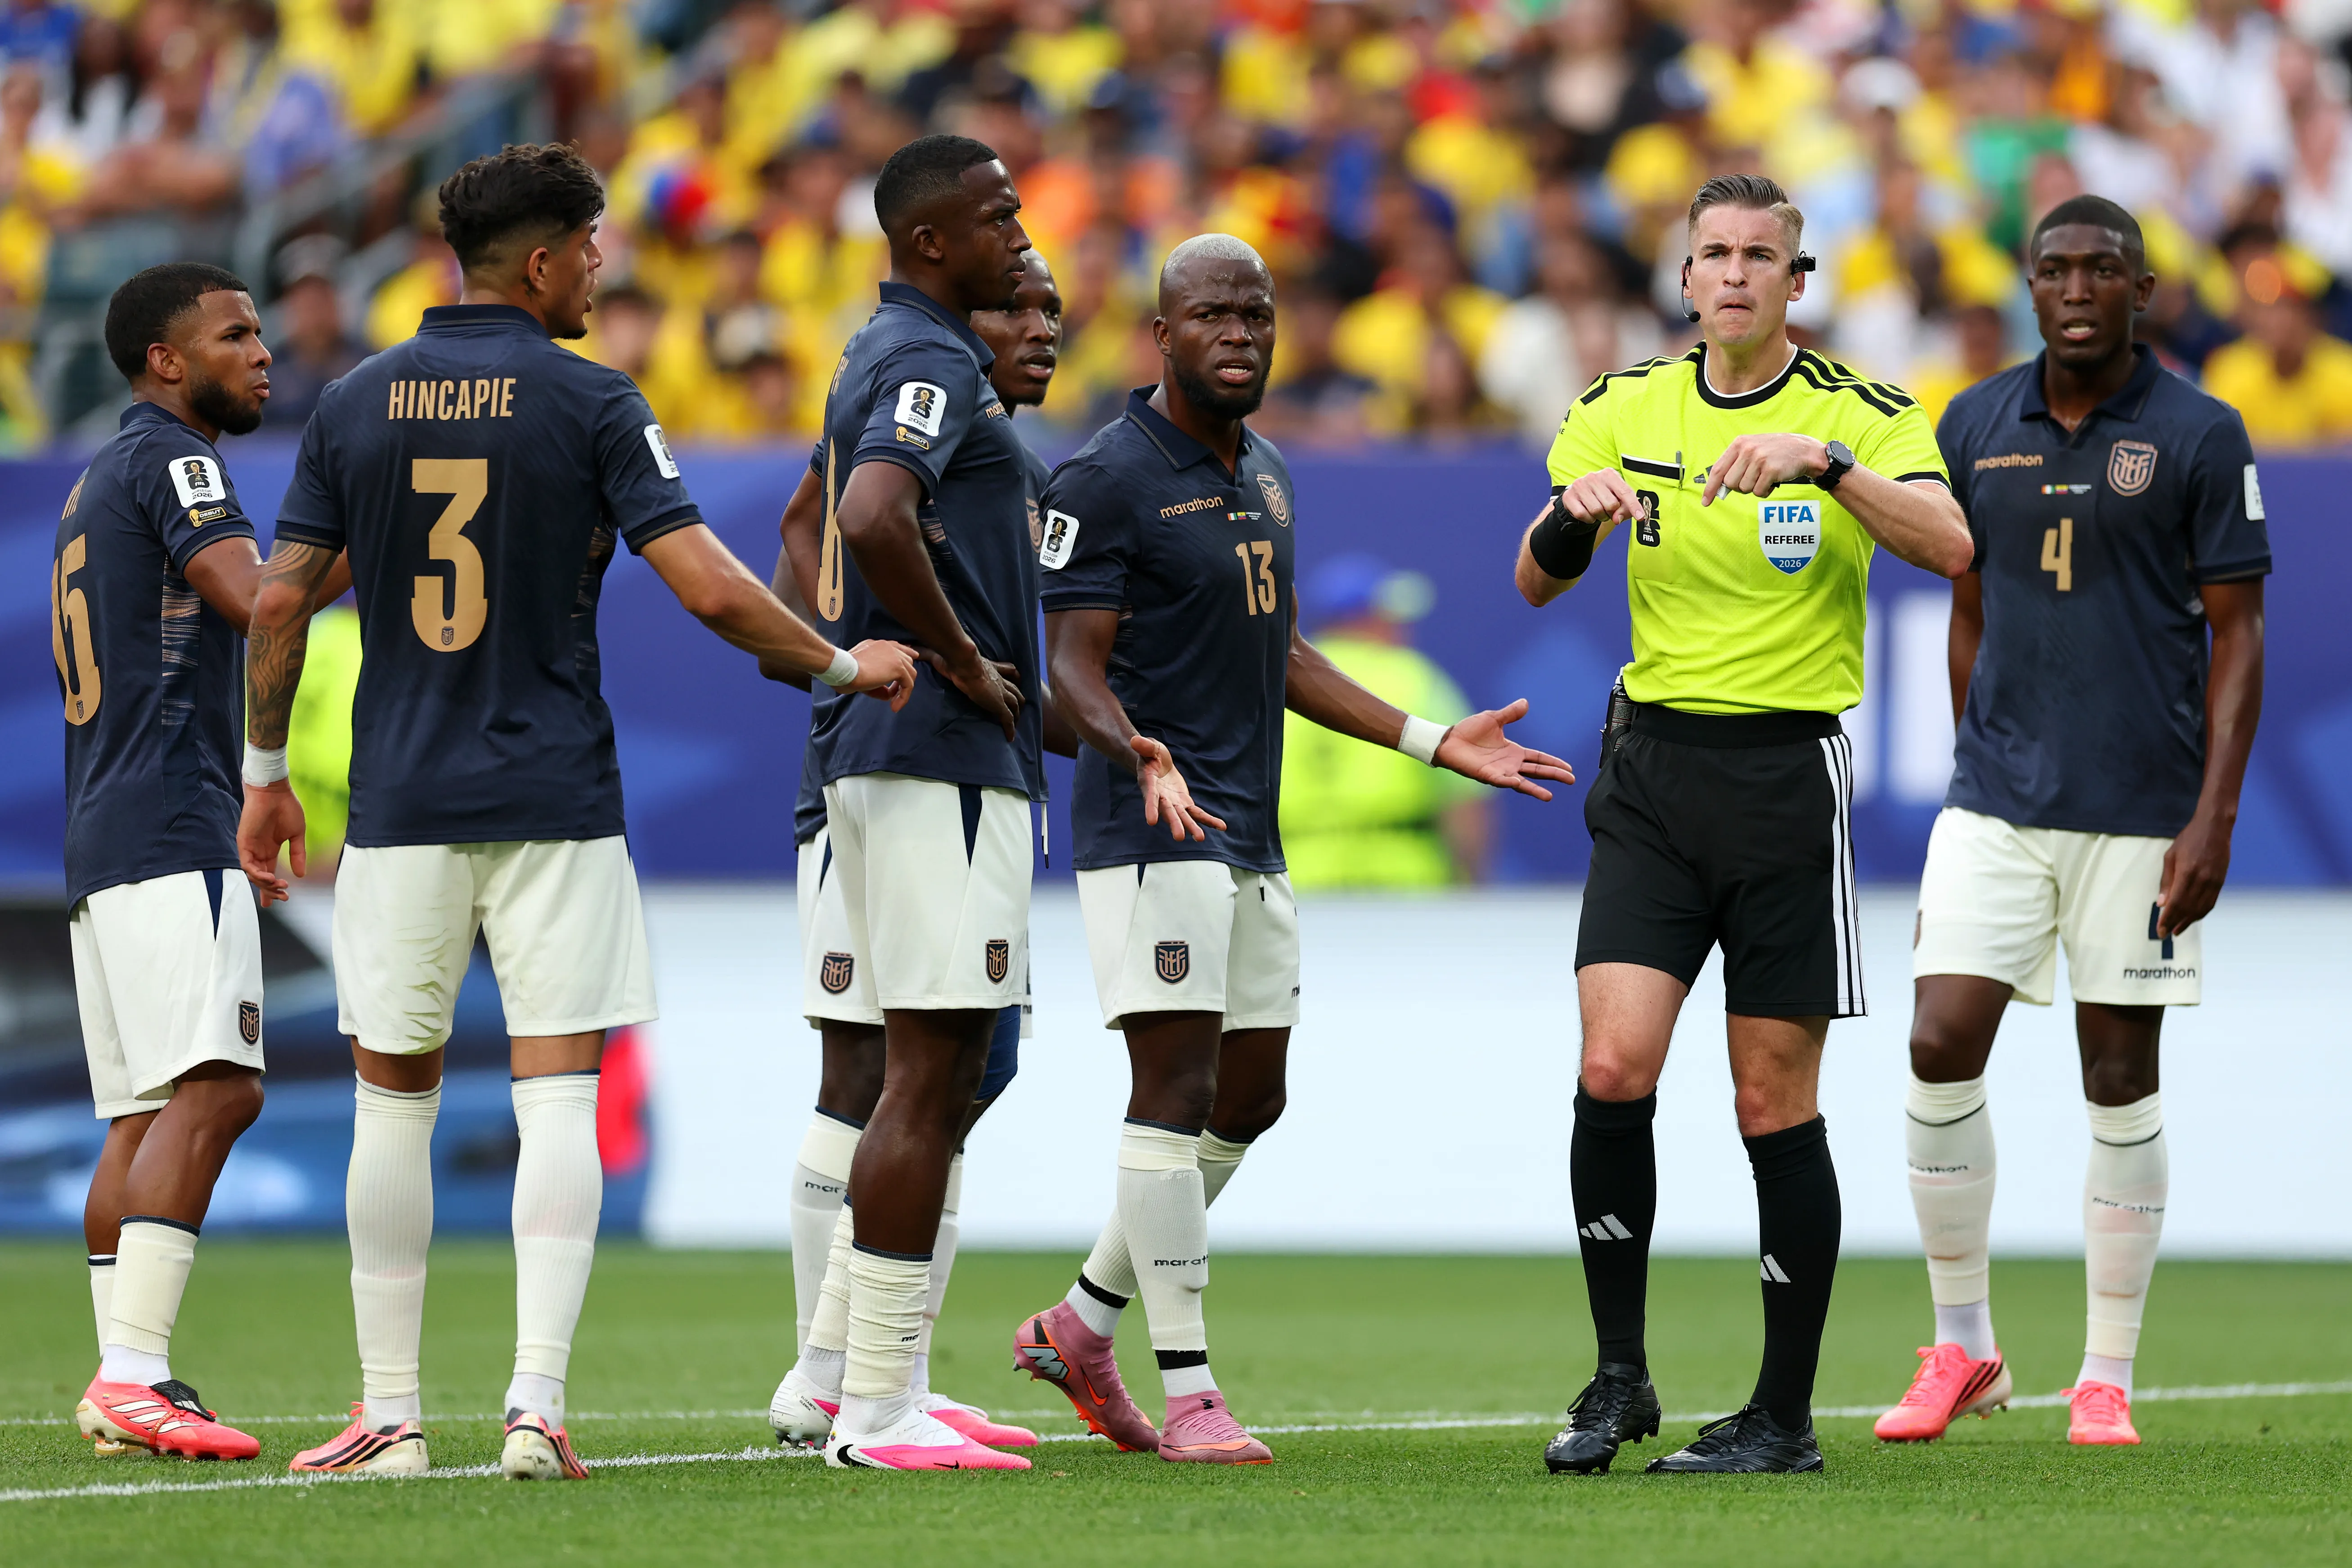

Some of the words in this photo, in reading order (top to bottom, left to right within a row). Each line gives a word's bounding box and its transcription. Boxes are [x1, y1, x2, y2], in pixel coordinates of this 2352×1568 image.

[388, 377, 516, 420] HINCAPIE
[916, 408, 926, 416] FIFA
[908, 417, 927, 429] 2026
[906, 433, 926, 445] DEBUT
[1974, 453, 2043, 471] marathon
[199, 509, 221, 517] DEBUT
[1160, 496, 1224, 518] marathon
[1764, 506, 1814, 523] FIFA
[1643, 534, 1654, 543] FIFA
[1765, 535, 1814, 544] REFEREE
[411, 458, 488, 652] 3
[1042, 555, 1056, 563] 2026
[2040, 518, 2073, 592] 4
[1779, 559, 1801, 568] 2026
[1235, 540, 1276, 616] 13
[51, 533, 101, 726] 15
[2123, 967, 2196, 979] marathon
[799, 1400, 811, 1411] GLENDA
[801, 1396, 817, 1411] ELIZABETH
[852, 1454, 873, 1464] RESILIENCIA
